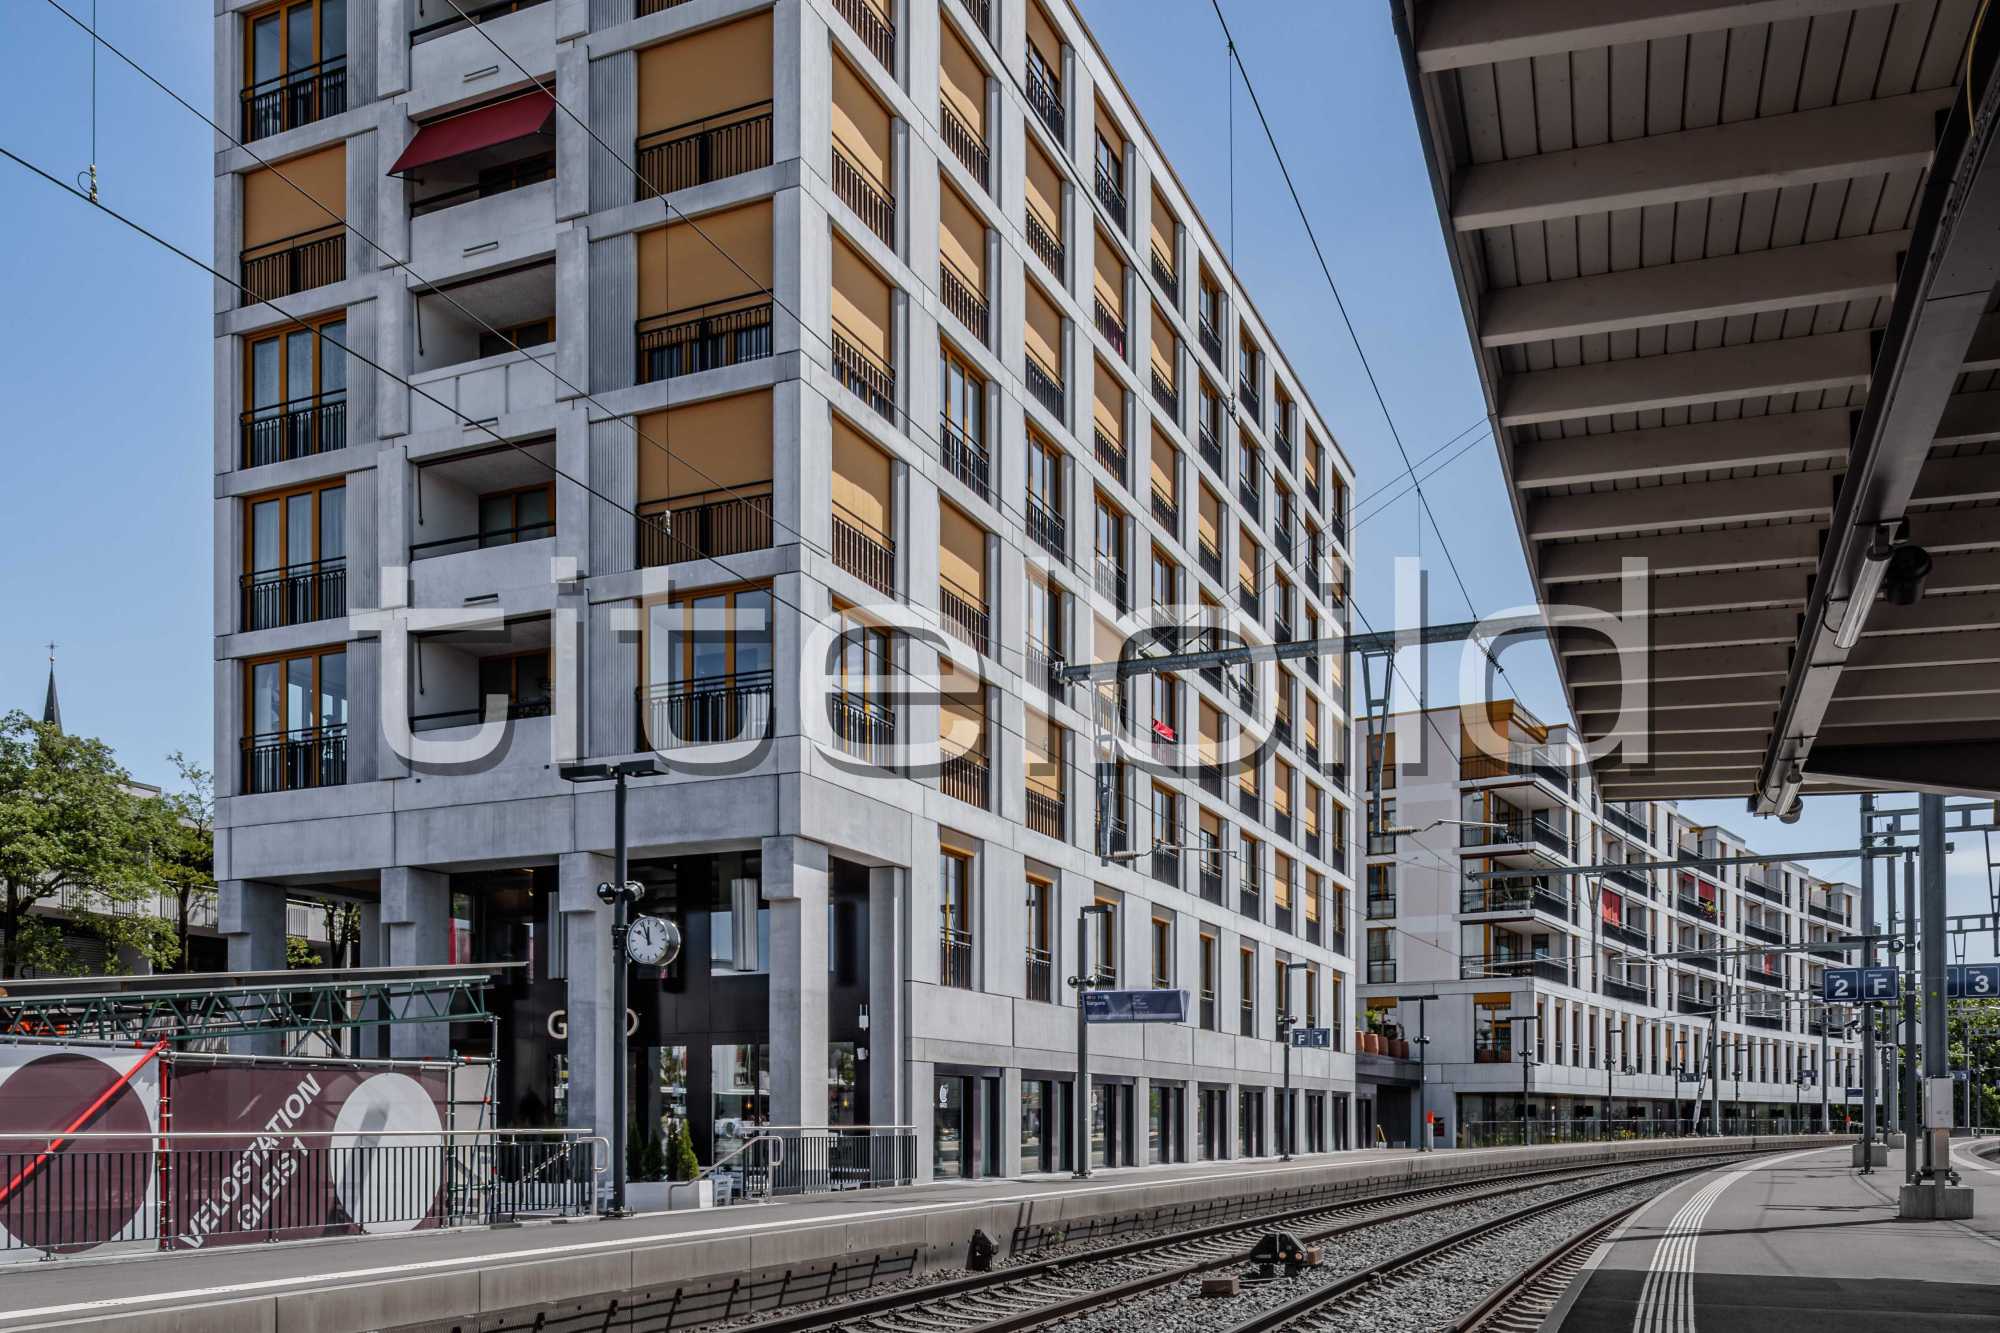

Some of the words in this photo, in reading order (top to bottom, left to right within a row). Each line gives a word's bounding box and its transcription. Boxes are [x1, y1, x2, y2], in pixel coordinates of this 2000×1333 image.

[1834, 979, 1849, 997] 2
[1873, 978, 1888, 995] F
[1974, 975, 1990, 993] 3
[1297, 1034, 1305, 1045] F
[1317, 1034, 1323, 1045] 1
[178, 1072, 321, 1249] VELOSTATION
[237, 1152, 297, 1230] GLEIS
[292, 1136, 308, 1157] 1
